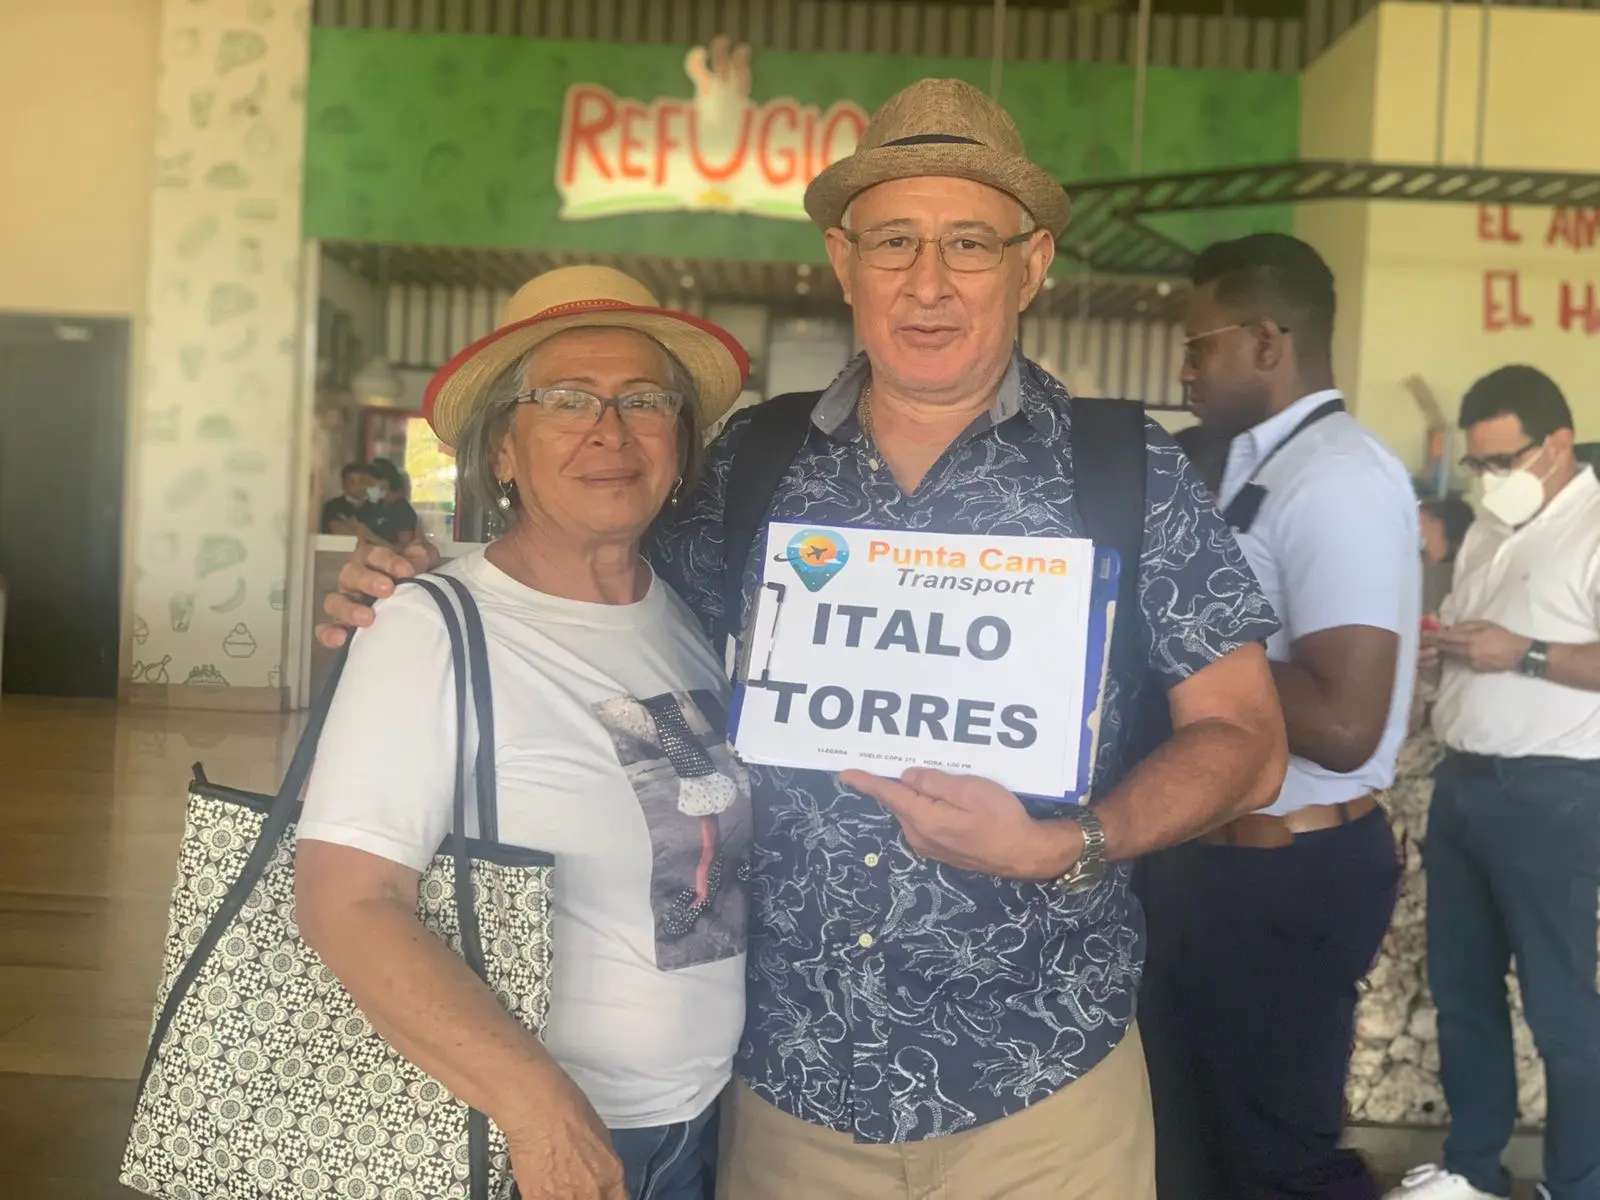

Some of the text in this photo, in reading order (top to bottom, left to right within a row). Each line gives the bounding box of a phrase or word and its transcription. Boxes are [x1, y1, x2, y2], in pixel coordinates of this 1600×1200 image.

[563, 86, 868, 187] REFUGIO
[1477, 203, 1521, 242] EL
[1484, 270, 1532, 331] EL
[868, 540, 1067, 575] Punta Cana
[897, 568, 1035, 596] Transport
[812, 603, 1012, 661] ITALO
[765, 680, 1038, 749] TORRES
